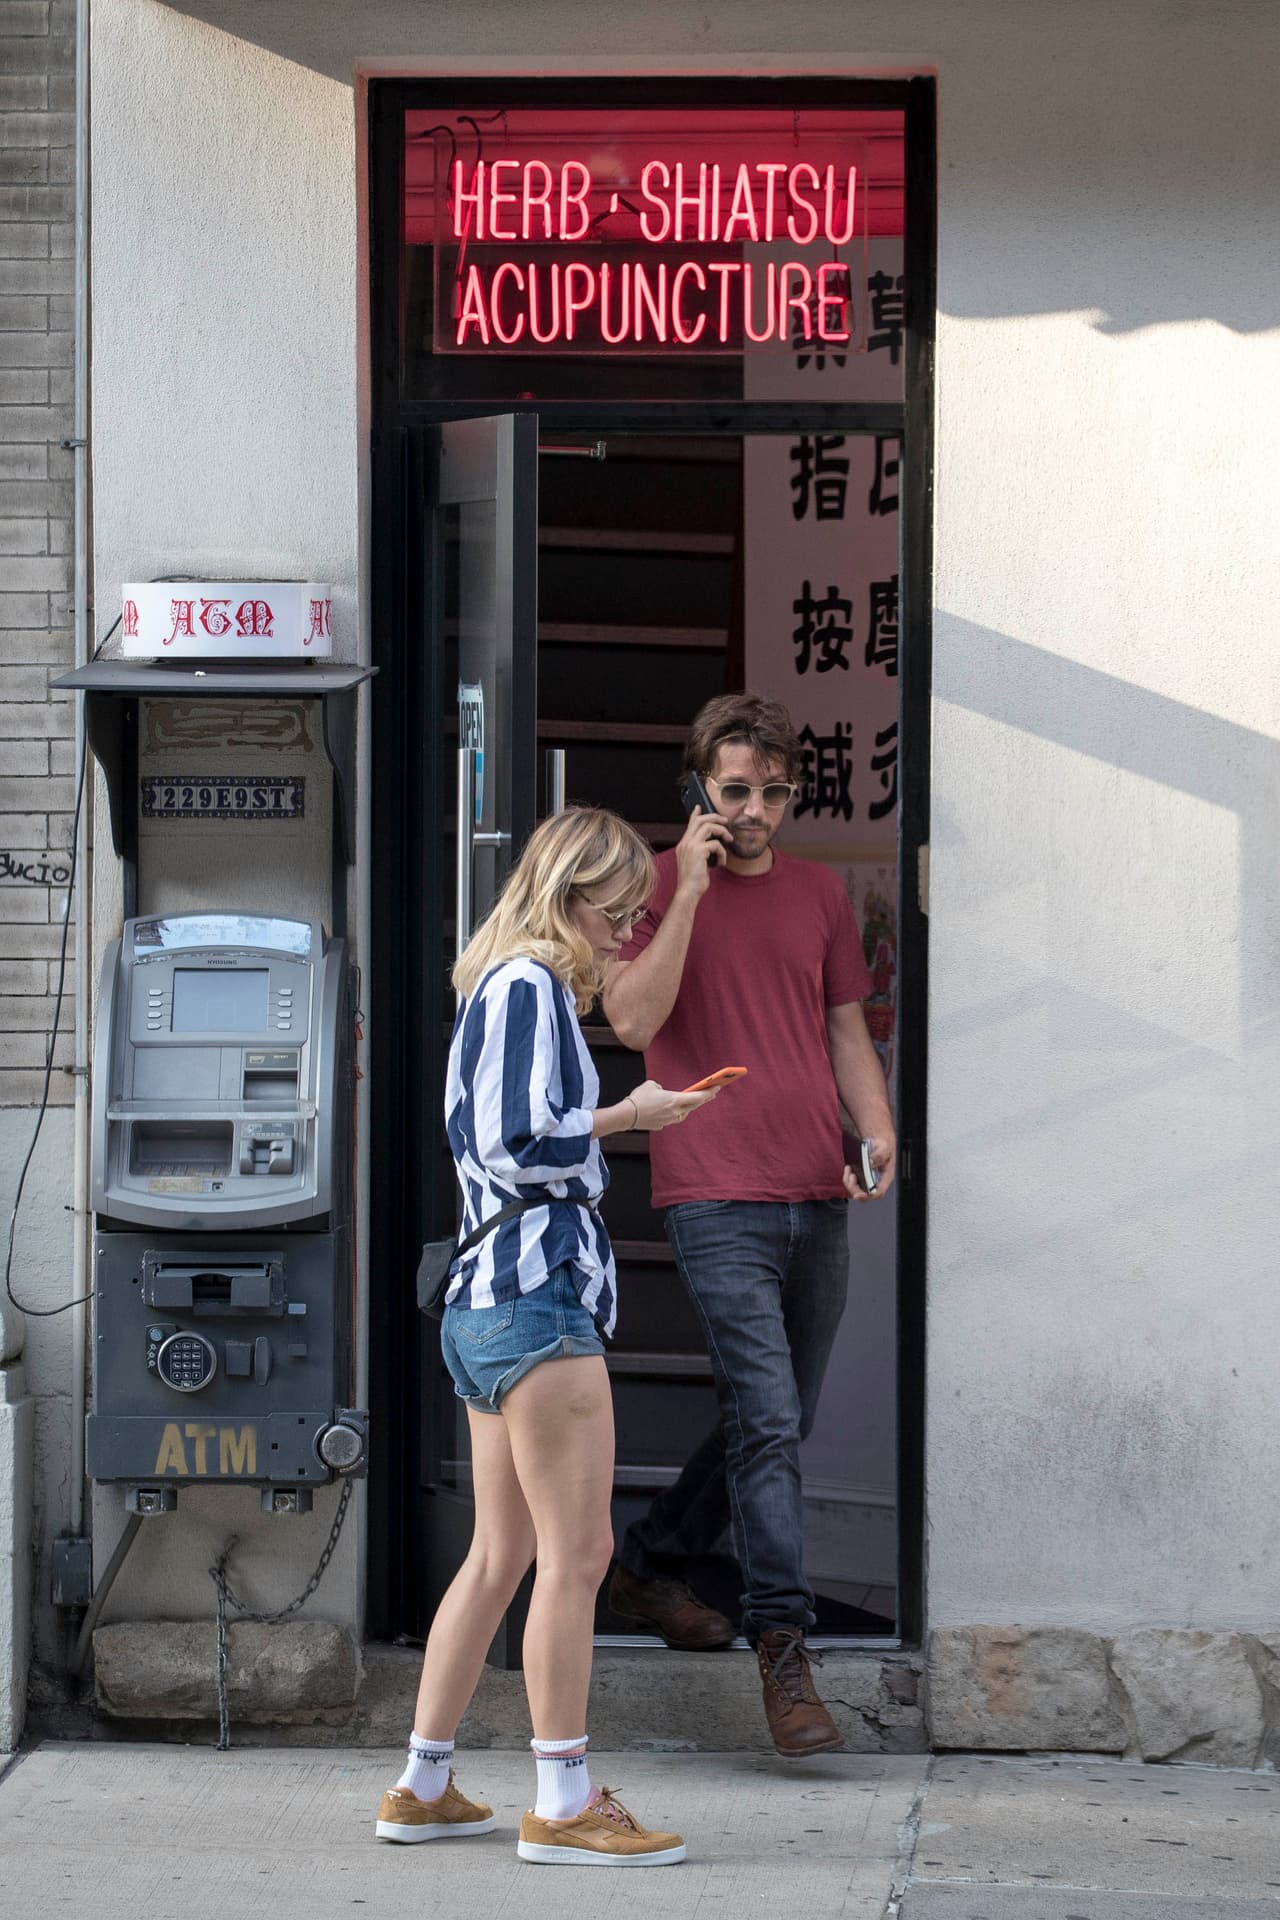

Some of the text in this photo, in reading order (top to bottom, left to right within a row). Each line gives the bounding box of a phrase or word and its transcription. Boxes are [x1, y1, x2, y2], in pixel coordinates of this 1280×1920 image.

[454, 159, 858, 245] HERB SHIATSU
[455, 262, 850, 345] ACUPUNCTURE
[162, 597, 276, 646] ATM
[461, 701, 483, 748] OPEN
[154, 1423, 257, 1475] ATM
